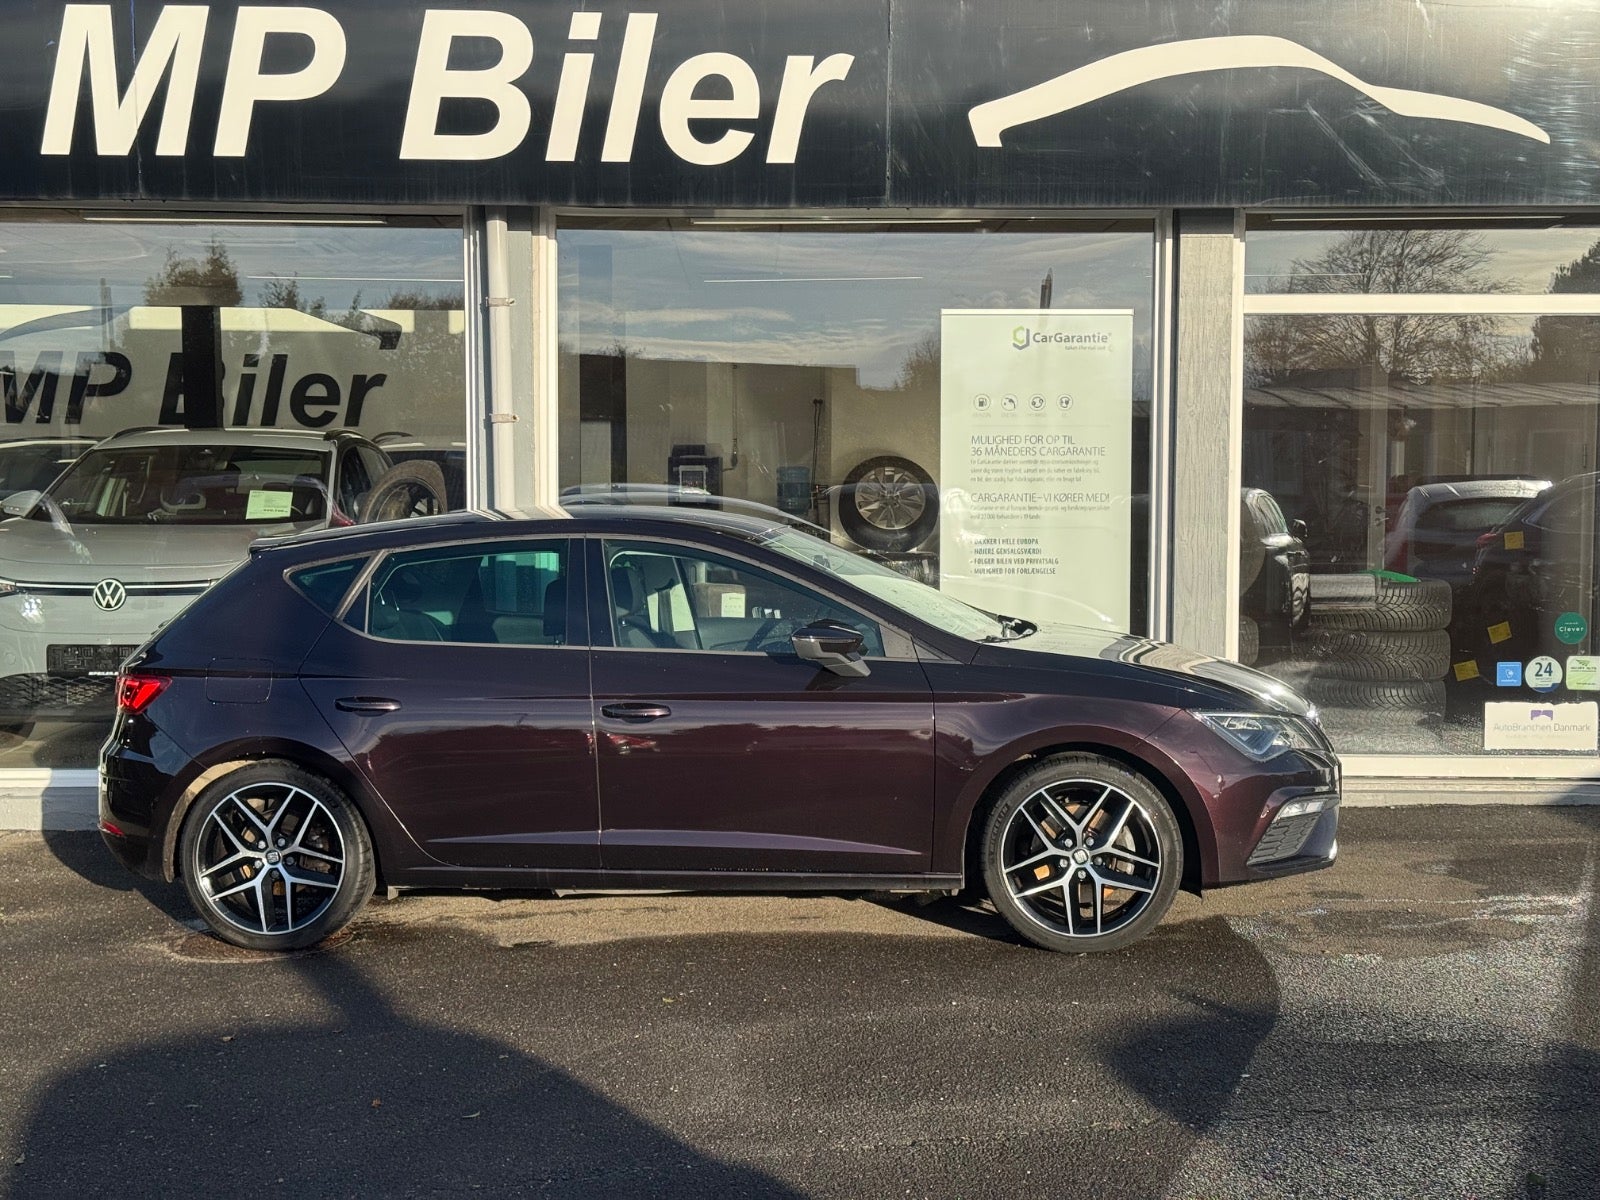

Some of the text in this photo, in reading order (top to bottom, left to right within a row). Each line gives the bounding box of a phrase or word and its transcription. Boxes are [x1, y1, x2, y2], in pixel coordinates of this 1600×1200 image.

[41, 4, 854, 166] MP Biler
[1032, 332, 1108, 343] CarGarantie
[0, 350, 132, 424] MP
[971, 434, 1076, 445] MULIGHED FOR OP TIL
[970, 444, 1106, 457] 36 MÅNEDERS CARGARANTIE
[1534, 661, 1553, 677] 24
[1553, 722, 1591, 732] Danmark
